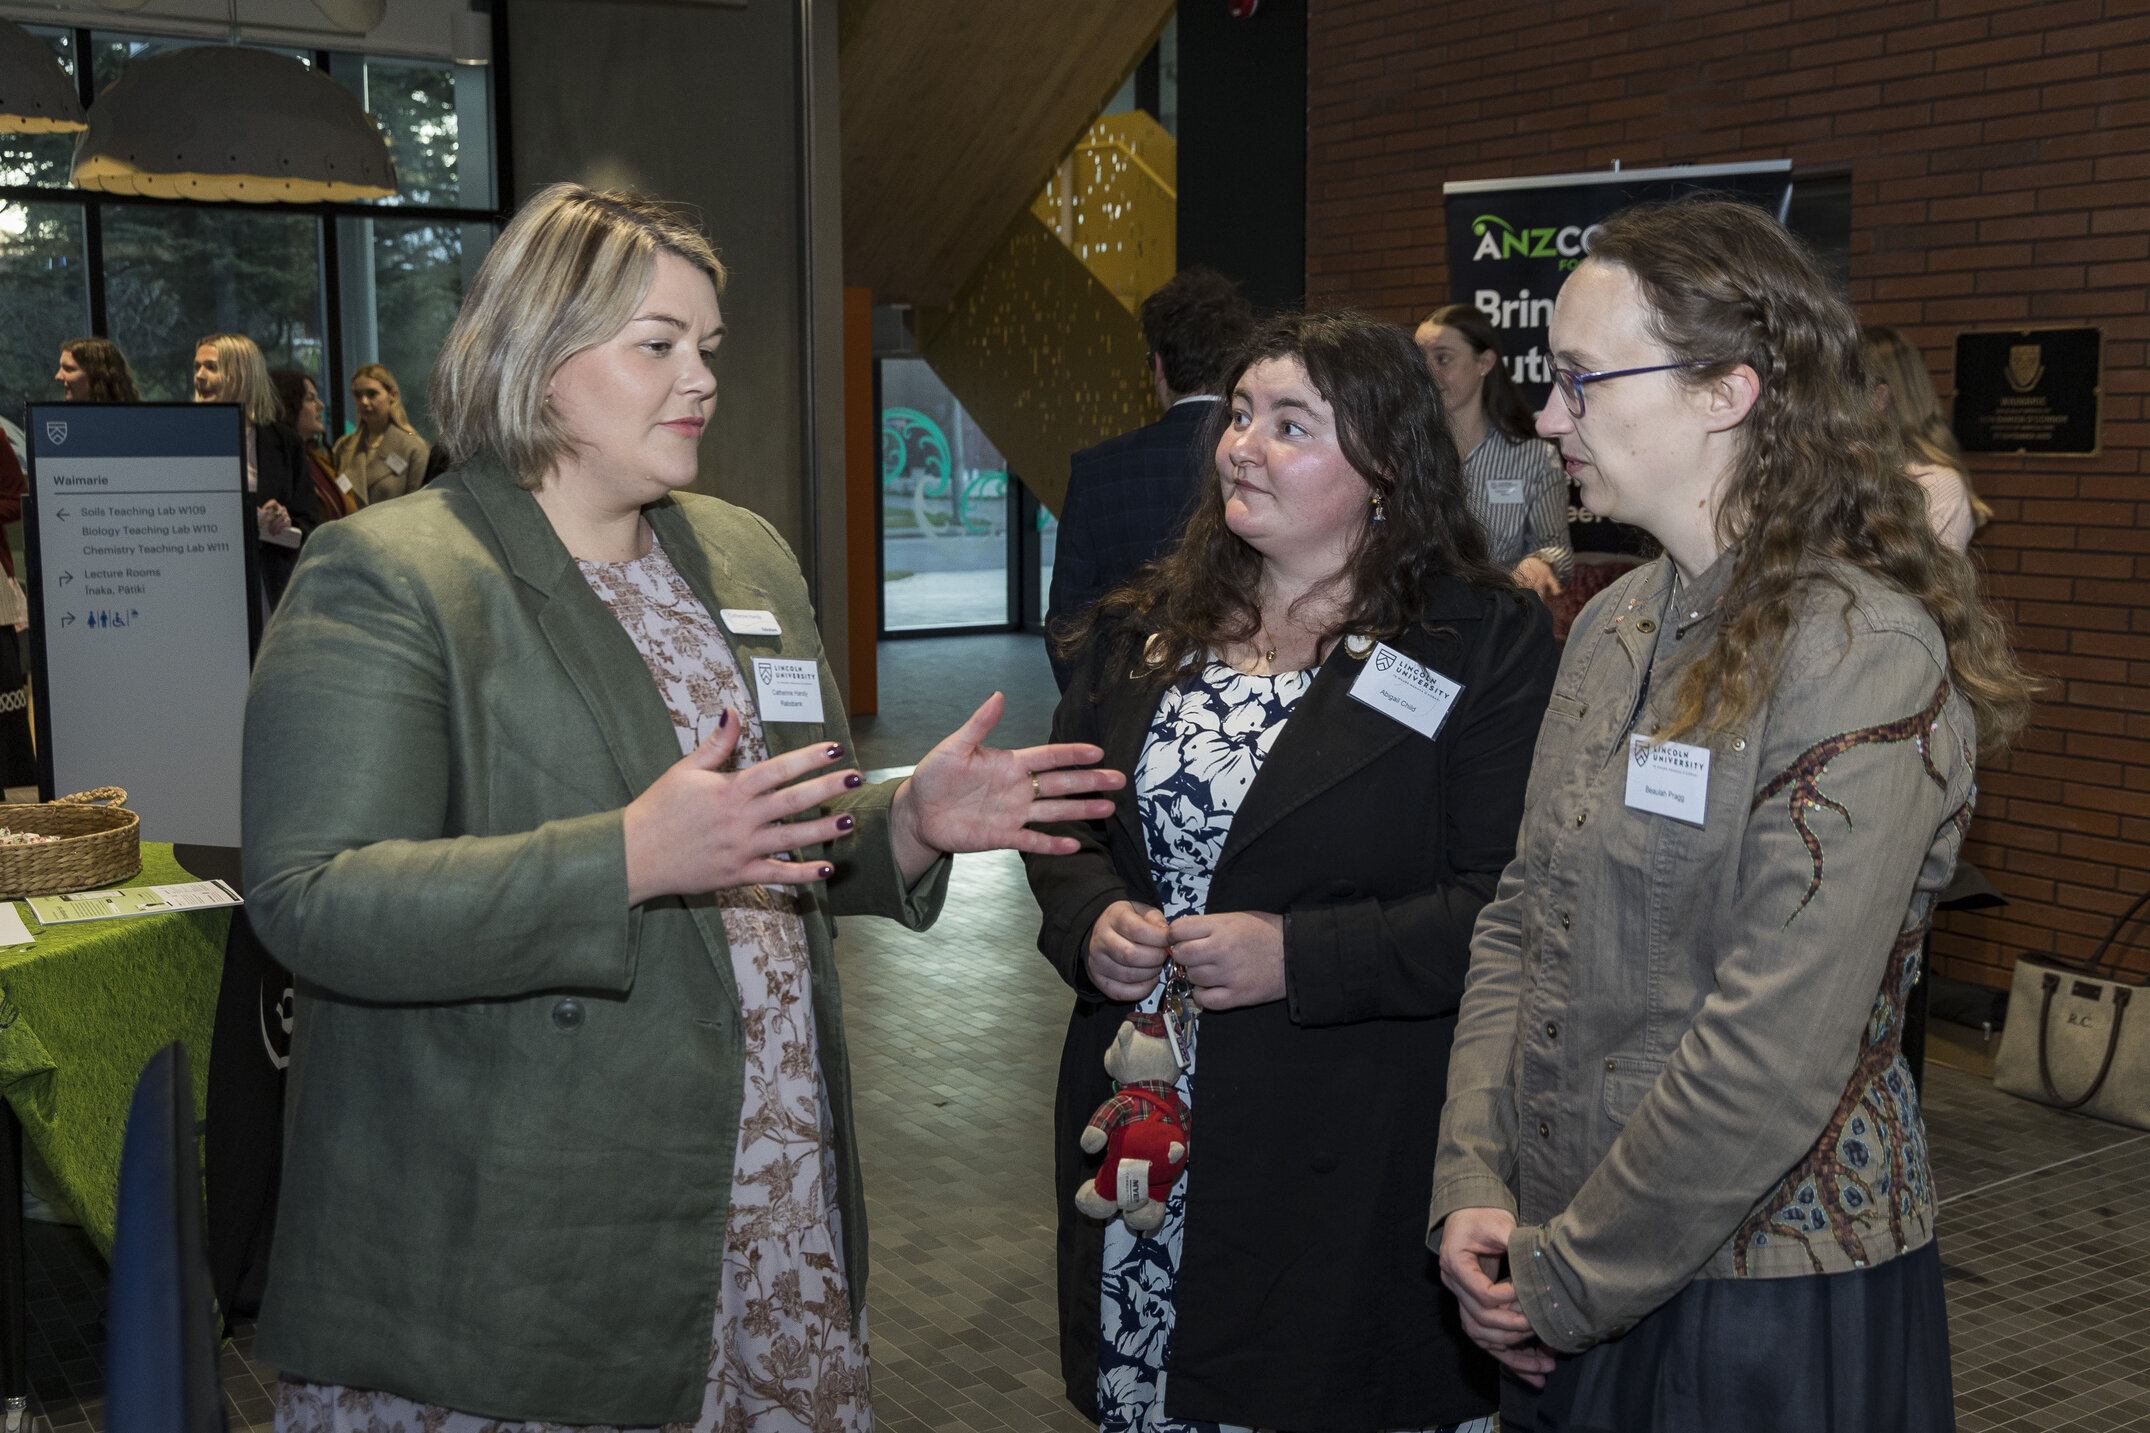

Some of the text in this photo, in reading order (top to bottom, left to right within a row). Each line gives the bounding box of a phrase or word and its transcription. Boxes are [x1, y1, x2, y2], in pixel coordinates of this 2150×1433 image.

[1558, 258, 1584, 272] FO
[53, 474, 109, 486] Waimarie
[81, 504, 207, 518] Soils Teaching Lab W109
[82, 524, 218, 537] Biology Teaching Lab W110
[83, 543, 230, 556] Chemistry Teaching Lab W111
[84, 567, 161, 579] Lecture Rooms
[1399, 661, 1437, 685] LINCOLN
[1396, 667, 1450, 700] UNIVERSITY
[1380, 689, 1417, 713] Abigail Child
[1653, 745, 1689, 759] LINCOLN
[1653, 754, 1704, 771] UNIVERSITY
